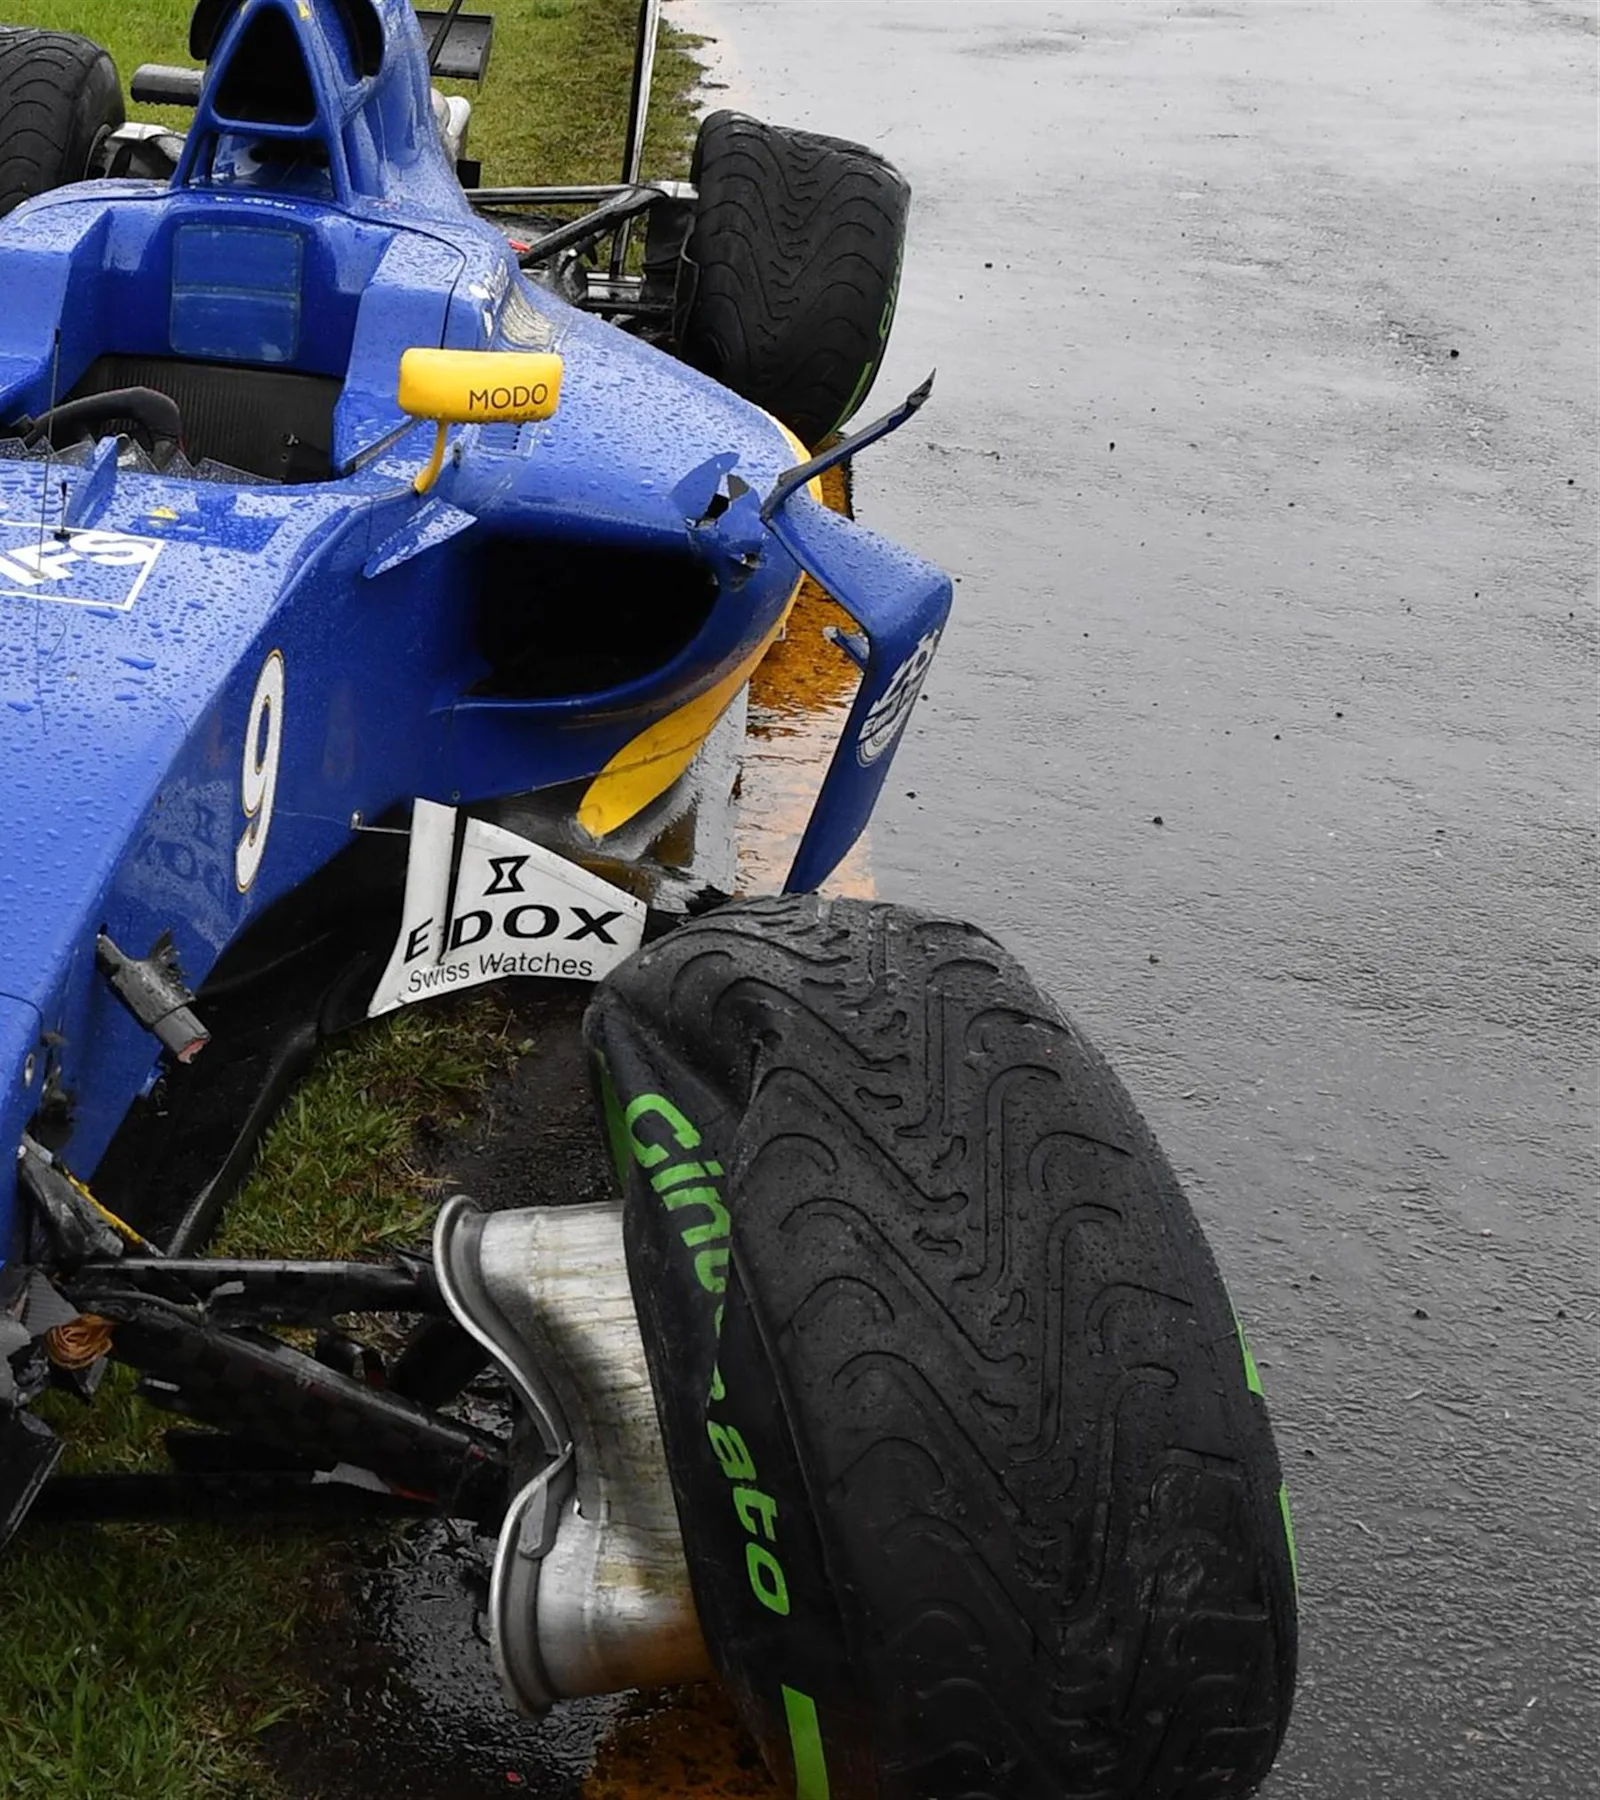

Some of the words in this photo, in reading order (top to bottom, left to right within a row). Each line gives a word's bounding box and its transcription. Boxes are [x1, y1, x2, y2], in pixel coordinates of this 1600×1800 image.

[468, 383, 548, 411] MODO
[236, 648, 285, 893] 9
[407, 962, 471, 993] Swiss
[479, 951, 594, 977] Watches
